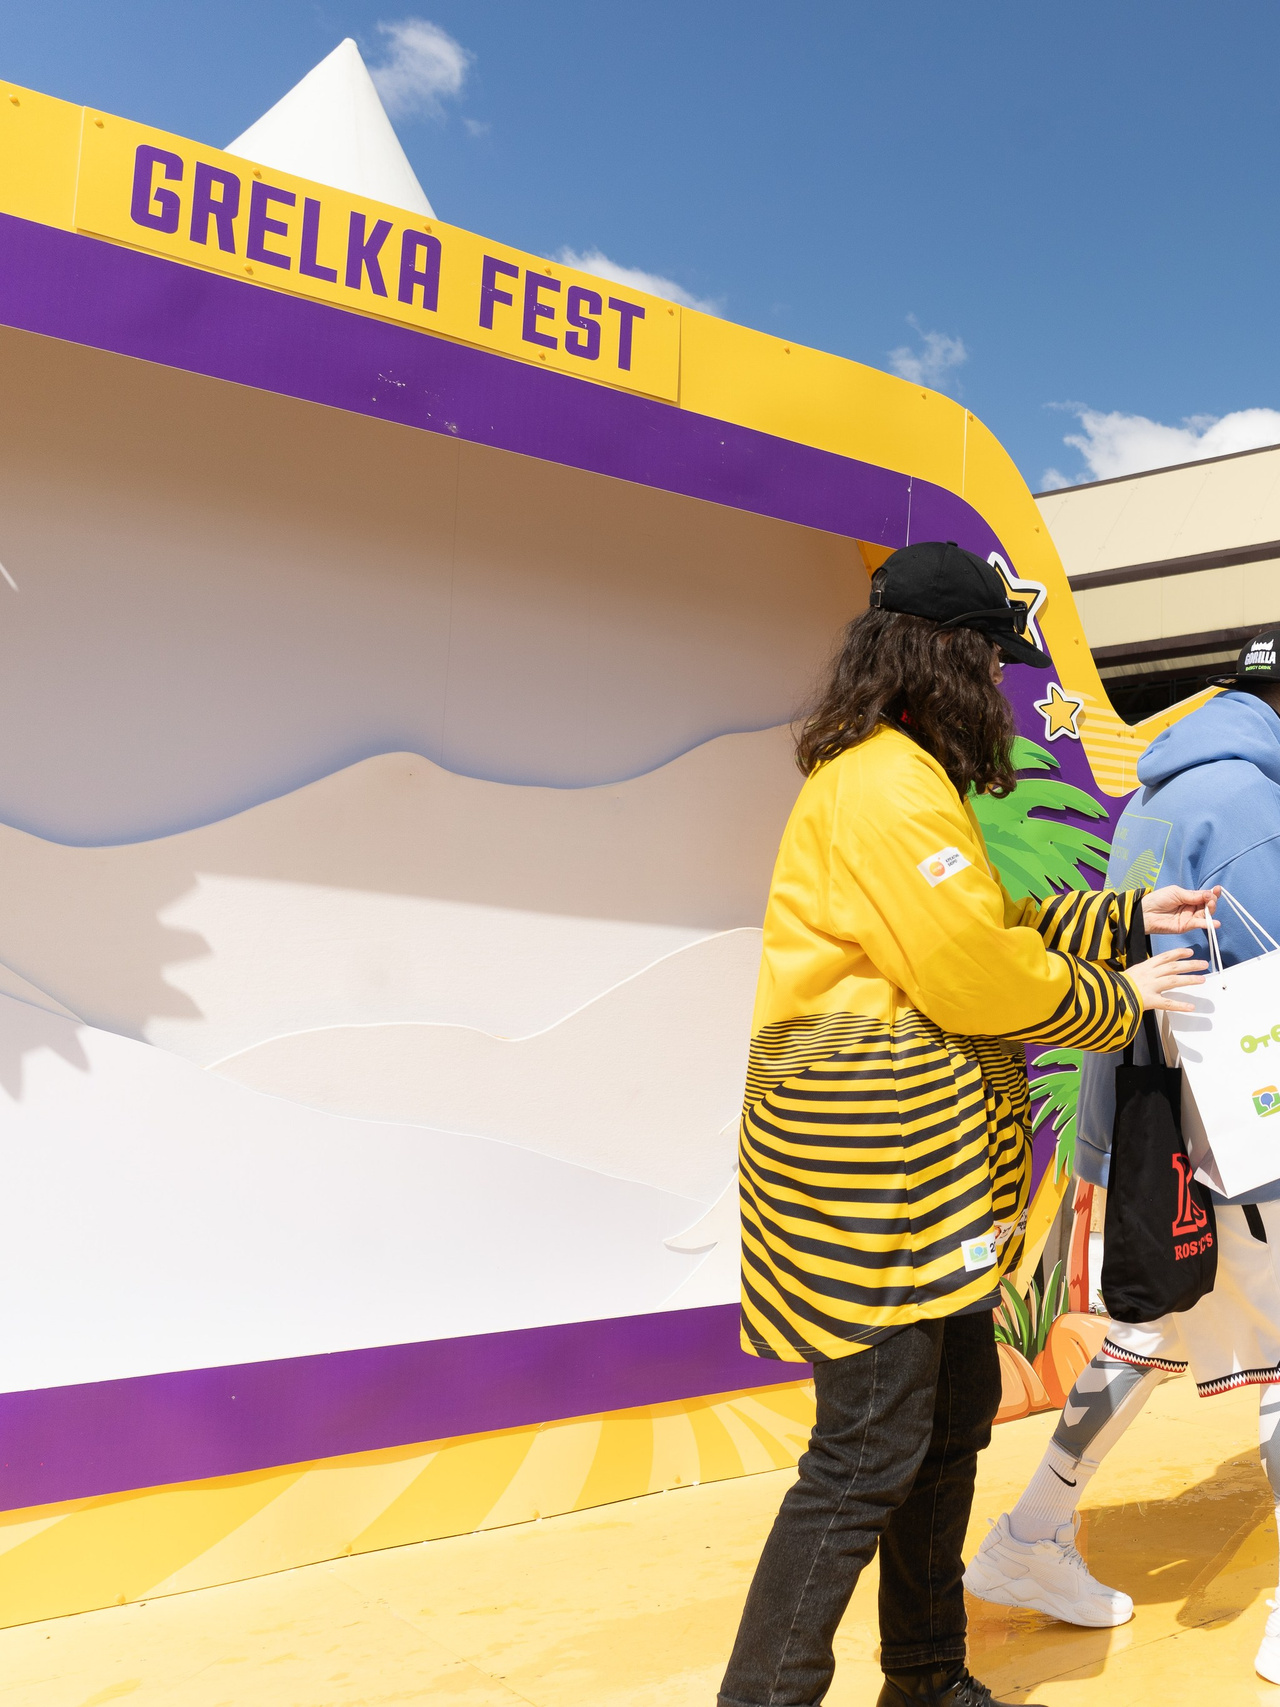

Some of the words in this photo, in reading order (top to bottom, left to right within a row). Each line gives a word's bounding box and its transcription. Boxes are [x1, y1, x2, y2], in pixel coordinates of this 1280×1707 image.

[130, 144, 442, 313] GRELKA
[479, 254, 646, 372] FEST
[1245, 651, 1276, 665] GORILLA
